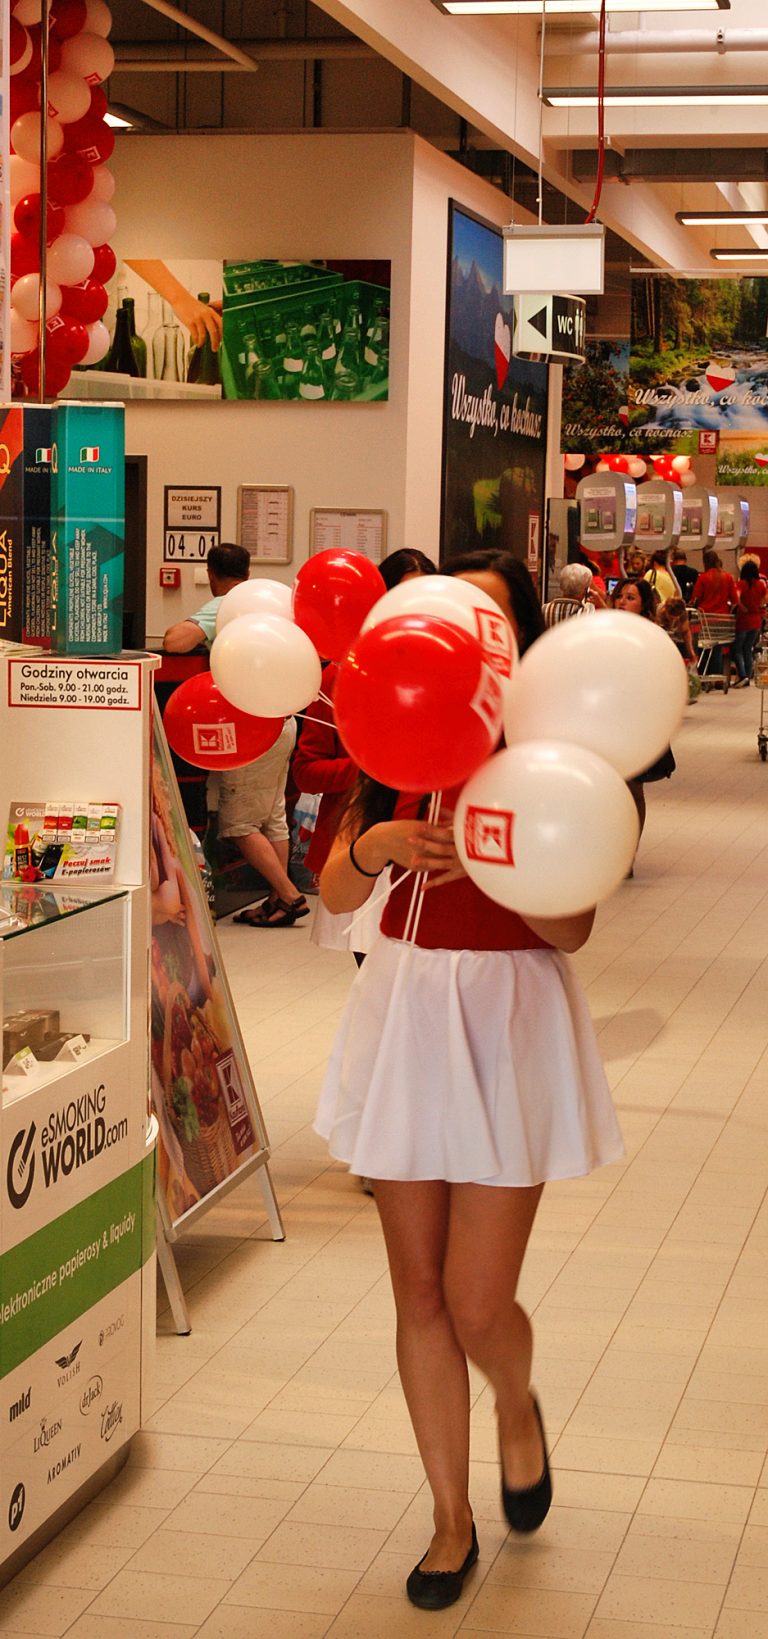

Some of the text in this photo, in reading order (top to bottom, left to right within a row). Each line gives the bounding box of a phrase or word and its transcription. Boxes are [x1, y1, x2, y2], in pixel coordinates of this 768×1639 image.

[557, 315, 573, 335] WC
[452, 372, 542, 438] Wszystko, co kochasz
[720, 396, 736, 406] co
[21, 664, 128, 682] Godziny otwarcia
[20, 682, 56, 692] Pon.-Sob.
[58, 683, 76, 692] 9.00
[82, 684, 104, 692] 21.00
[106, 684, 128, 694] godz.
[20, 694, 57, 702] Niedziela
[59, 694, 77, 702] 9.00
[84, 695, 106, 704] 19.00
[108, 696, 130, 706] godz.
[62, 866, 110, 876] E-papierosów
[63, 857, 111, 868] Poczuj smak
[41, 1084, 106, 1148] eSMOKING
[42, 1116, 128, 1188] WORLD.com
[59, 1237, 100, 1286] papierosy
[102, 1231, 108, 1249] &
[110, 1212, 136, 1244] liquidy
[57, 1362, 81, 1388] VOLISH
[10, 1386, 32, 1422] mild
[47, 1443, 82, 1484] AROMATIV
